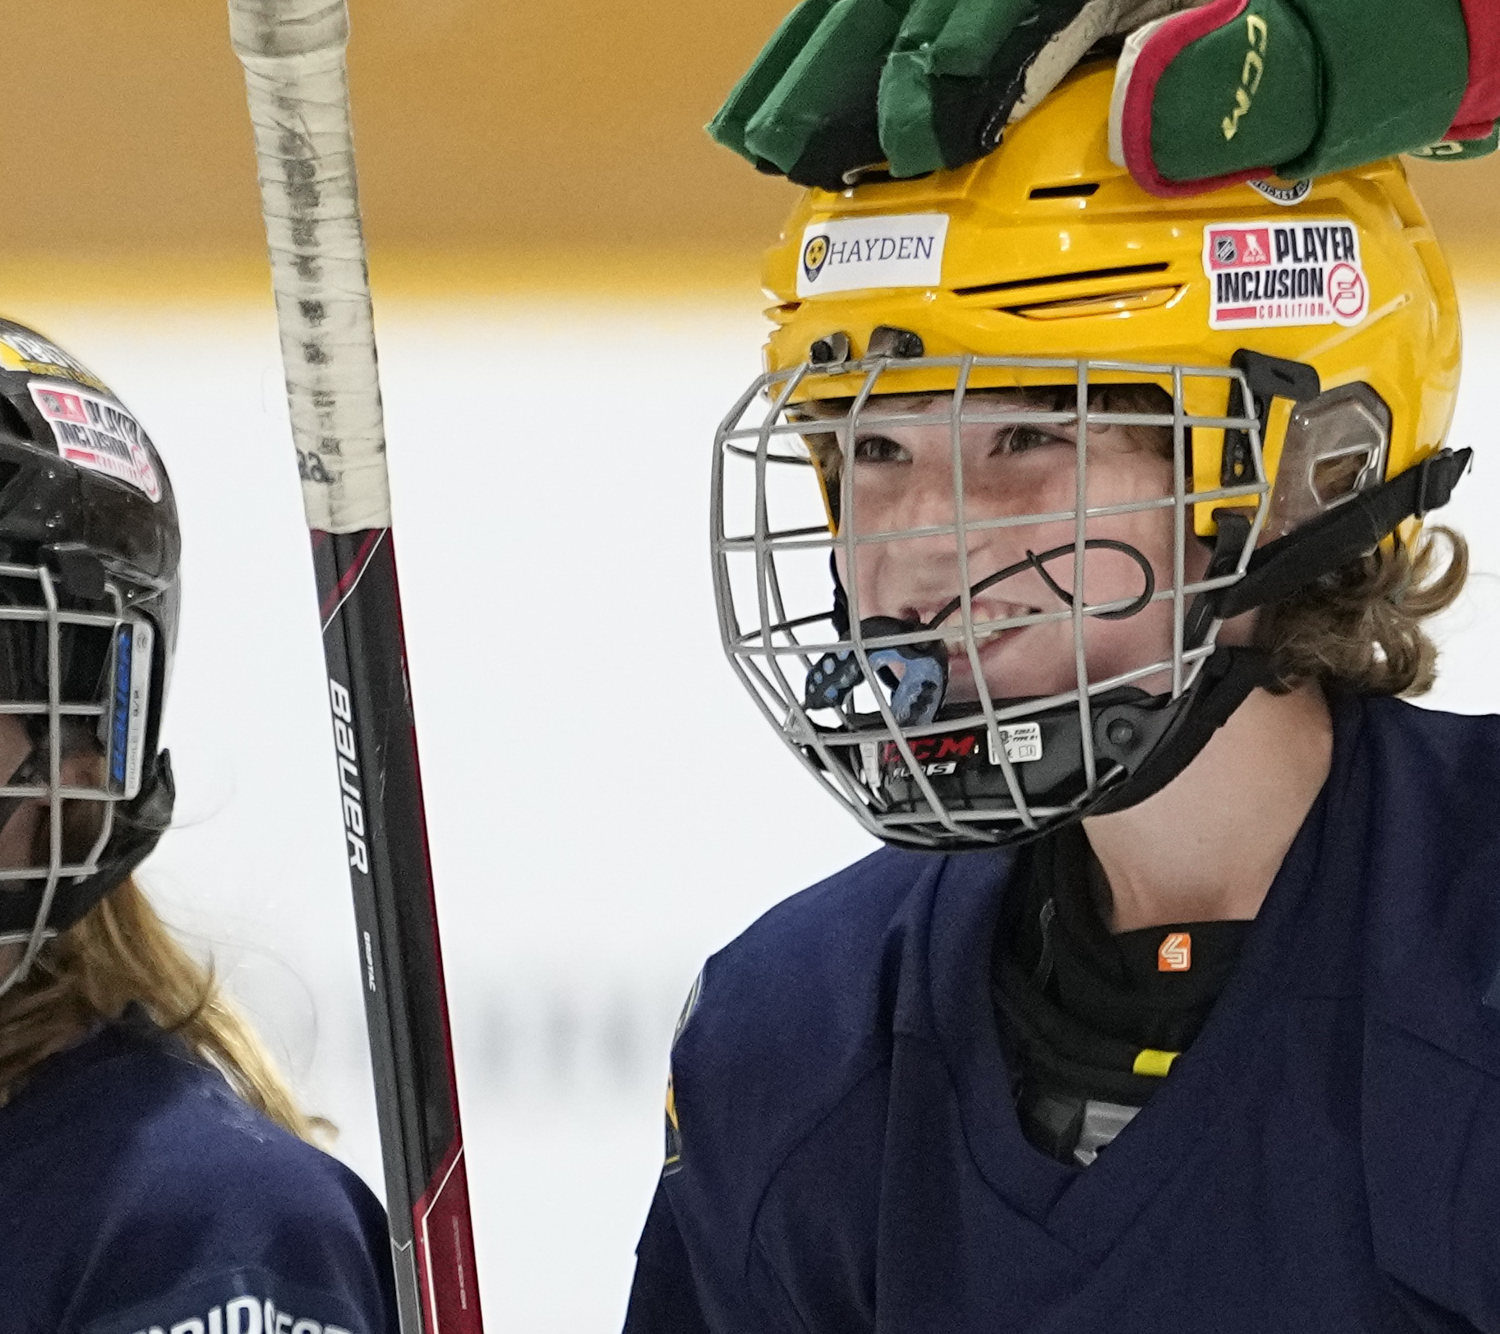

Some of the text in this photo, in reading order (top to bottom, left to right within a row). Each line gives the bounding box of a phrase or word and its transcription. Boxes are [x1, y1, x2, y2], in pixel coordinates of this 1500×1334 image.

[1221, 13, 1268, 142] CCM
[827, 235, 935, 266] HAYDEN
[1274, 225, 1356, 264] PLAYER
[1216, 267, 1324, 305] INCLUSION
[1258, 304, 1325, 320] COALITION
